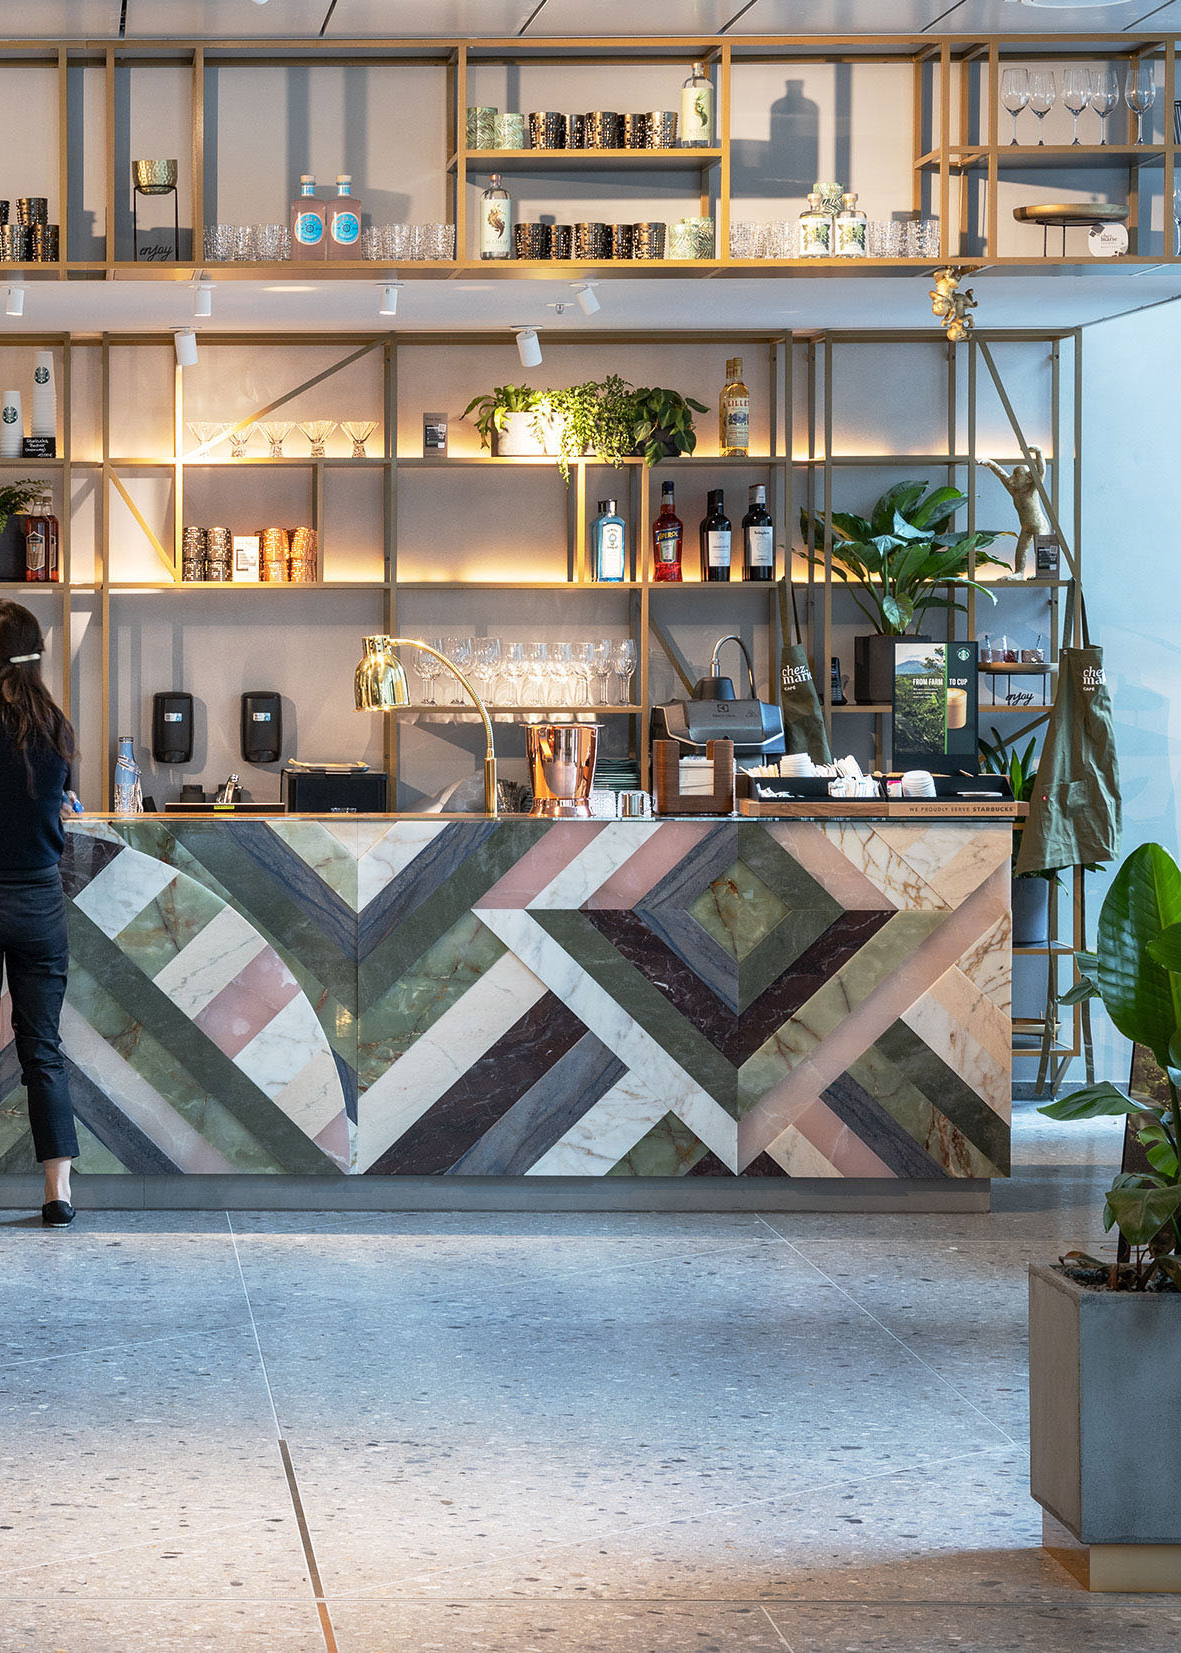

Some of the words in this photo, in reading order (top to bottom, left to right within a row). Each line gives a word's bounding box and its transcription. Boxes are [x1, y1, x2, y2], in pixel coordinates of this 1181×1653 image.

[140, 245, 173, 262] enjoy
[657, 530, 679, 541] APEROL
[782, 664, 806, 677] chez
[912, 678, 928, 686] FROM
[928, 678, 943, 686] FARM
[949, 678, 956, 686] TO
[956, 678, 968, 686] CUP
[1005, 692, 1035, 706] enjoy
